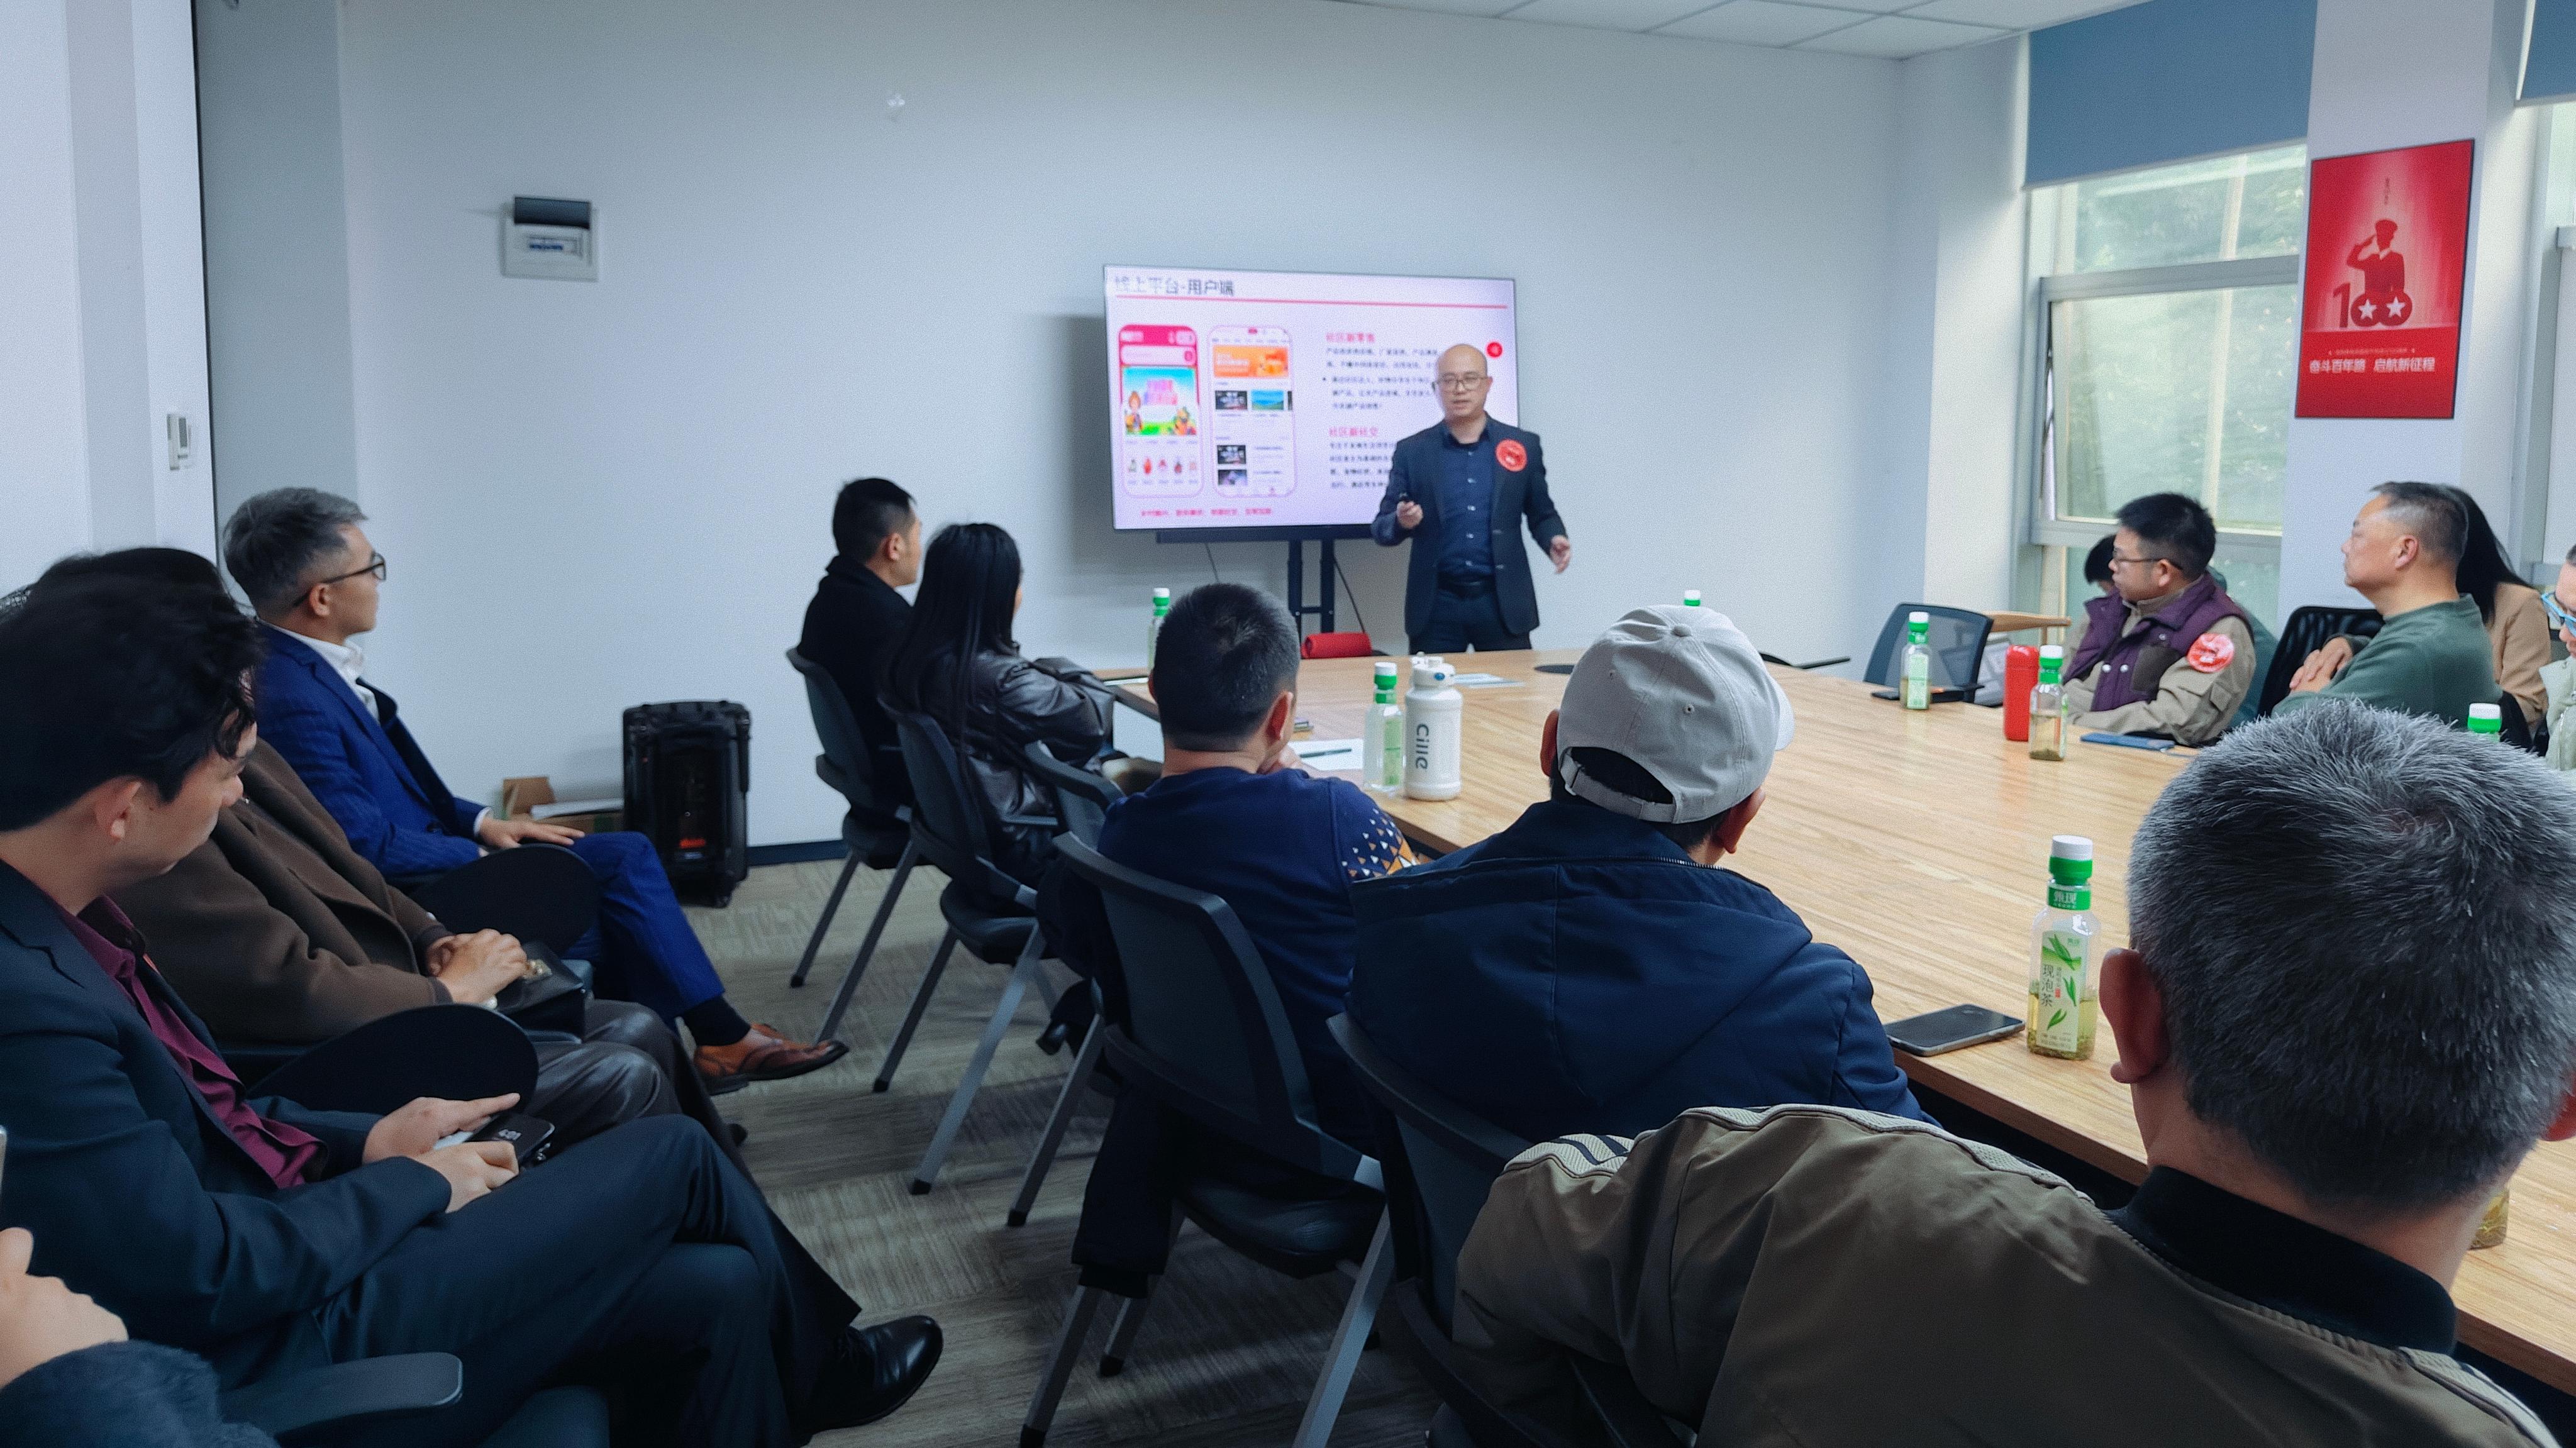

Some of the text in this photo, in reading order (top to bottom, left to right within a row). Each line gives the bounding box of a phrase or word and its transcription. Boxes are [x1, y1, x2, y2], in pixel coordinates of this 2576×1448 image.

[2309, 356, 2435, 374] 奋斗百年路 启航新征程
